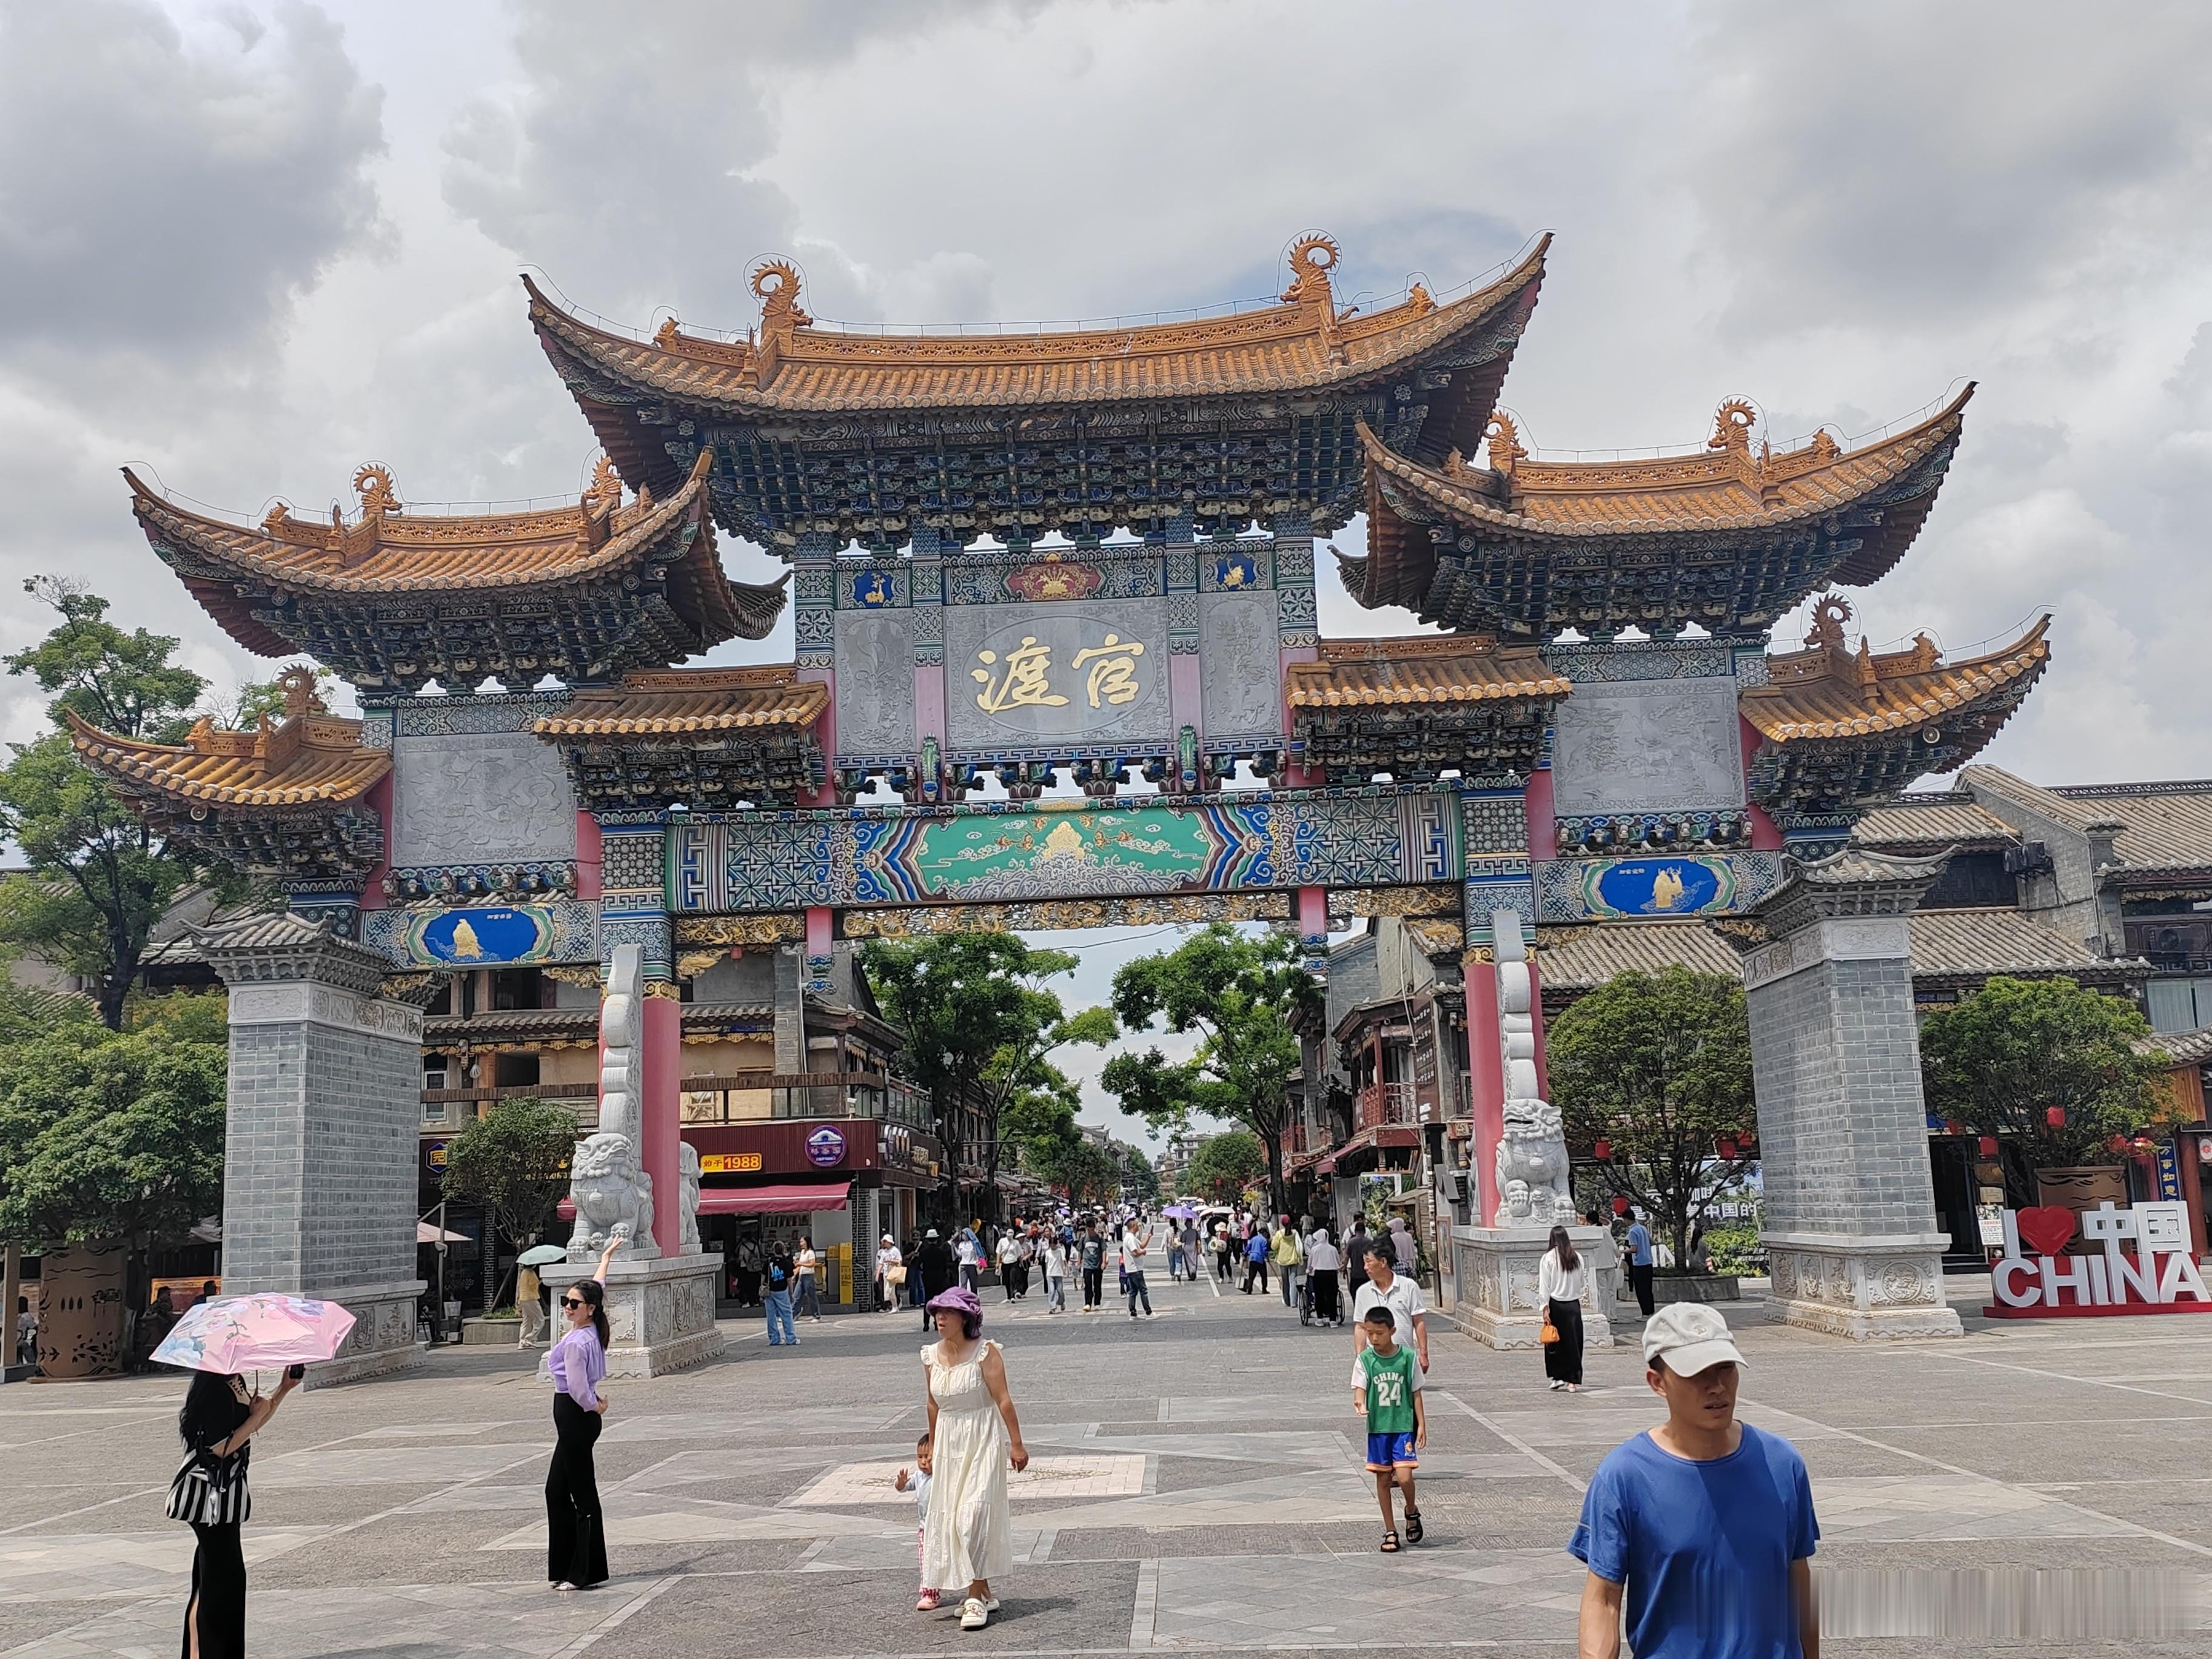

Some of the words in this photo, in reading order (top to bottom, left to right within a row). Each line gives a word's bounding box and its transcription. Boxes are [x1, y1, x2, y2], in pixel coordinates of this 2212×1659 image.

[2159, 1145, 2177, 1201] 万事如意
[2004, 1209, 2021, 1259] I
[2082, 1201, 2193, 1254] 中国
[1992, 1252, 2211, 1307] CHINA
[1378, 1382, 1401, 1407] 24
